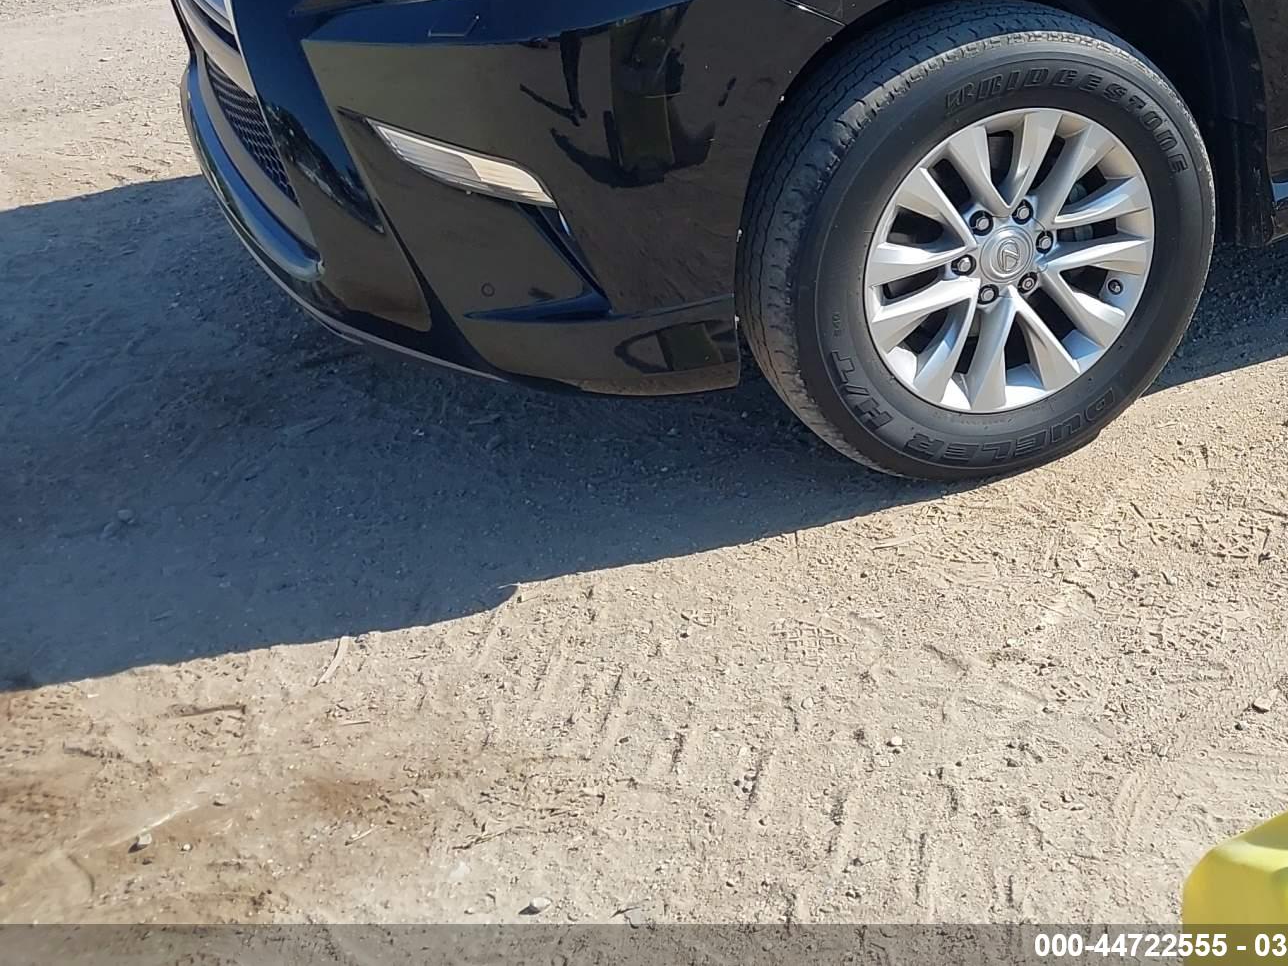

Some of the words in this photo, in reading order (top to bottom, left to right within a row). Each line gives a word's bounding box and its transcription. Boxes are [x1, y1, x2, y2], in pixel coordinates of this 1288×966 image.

[944, 67, 1189, 174] BRIDGESTONE
[830, 350, 893, 431] H/T
[904, 386, 1114, 463] DUELER
